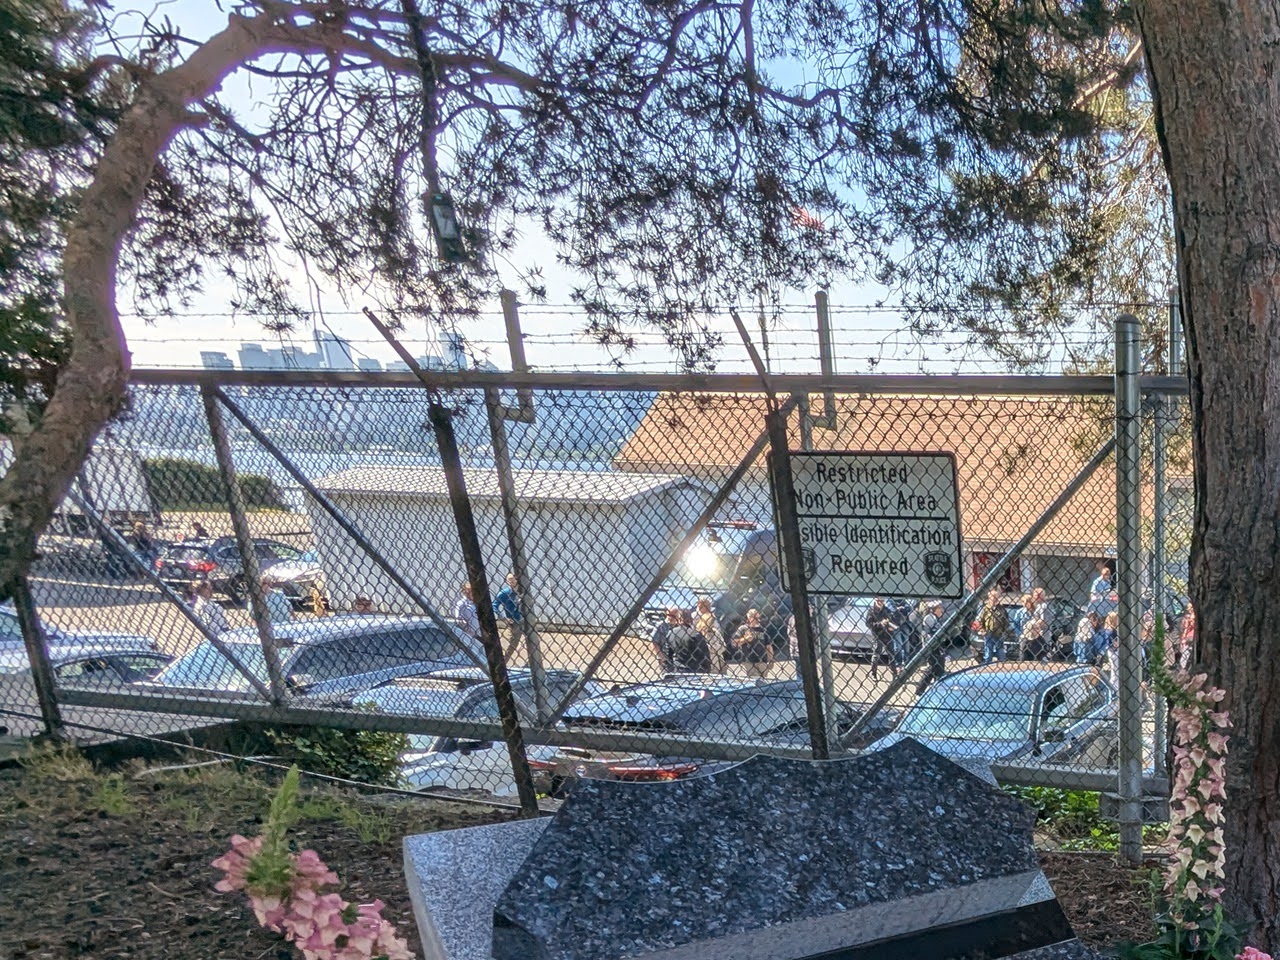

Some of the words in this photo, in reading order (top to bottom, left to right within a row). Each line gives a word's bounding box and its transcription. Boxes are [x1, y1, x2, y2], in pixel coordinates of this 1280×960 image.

[816, 463, 908, 483] Restricted
[896, 491, 938, 511] Area
[845, 524, 952, 546] Identification
[831, 554, 908, 578] Required
